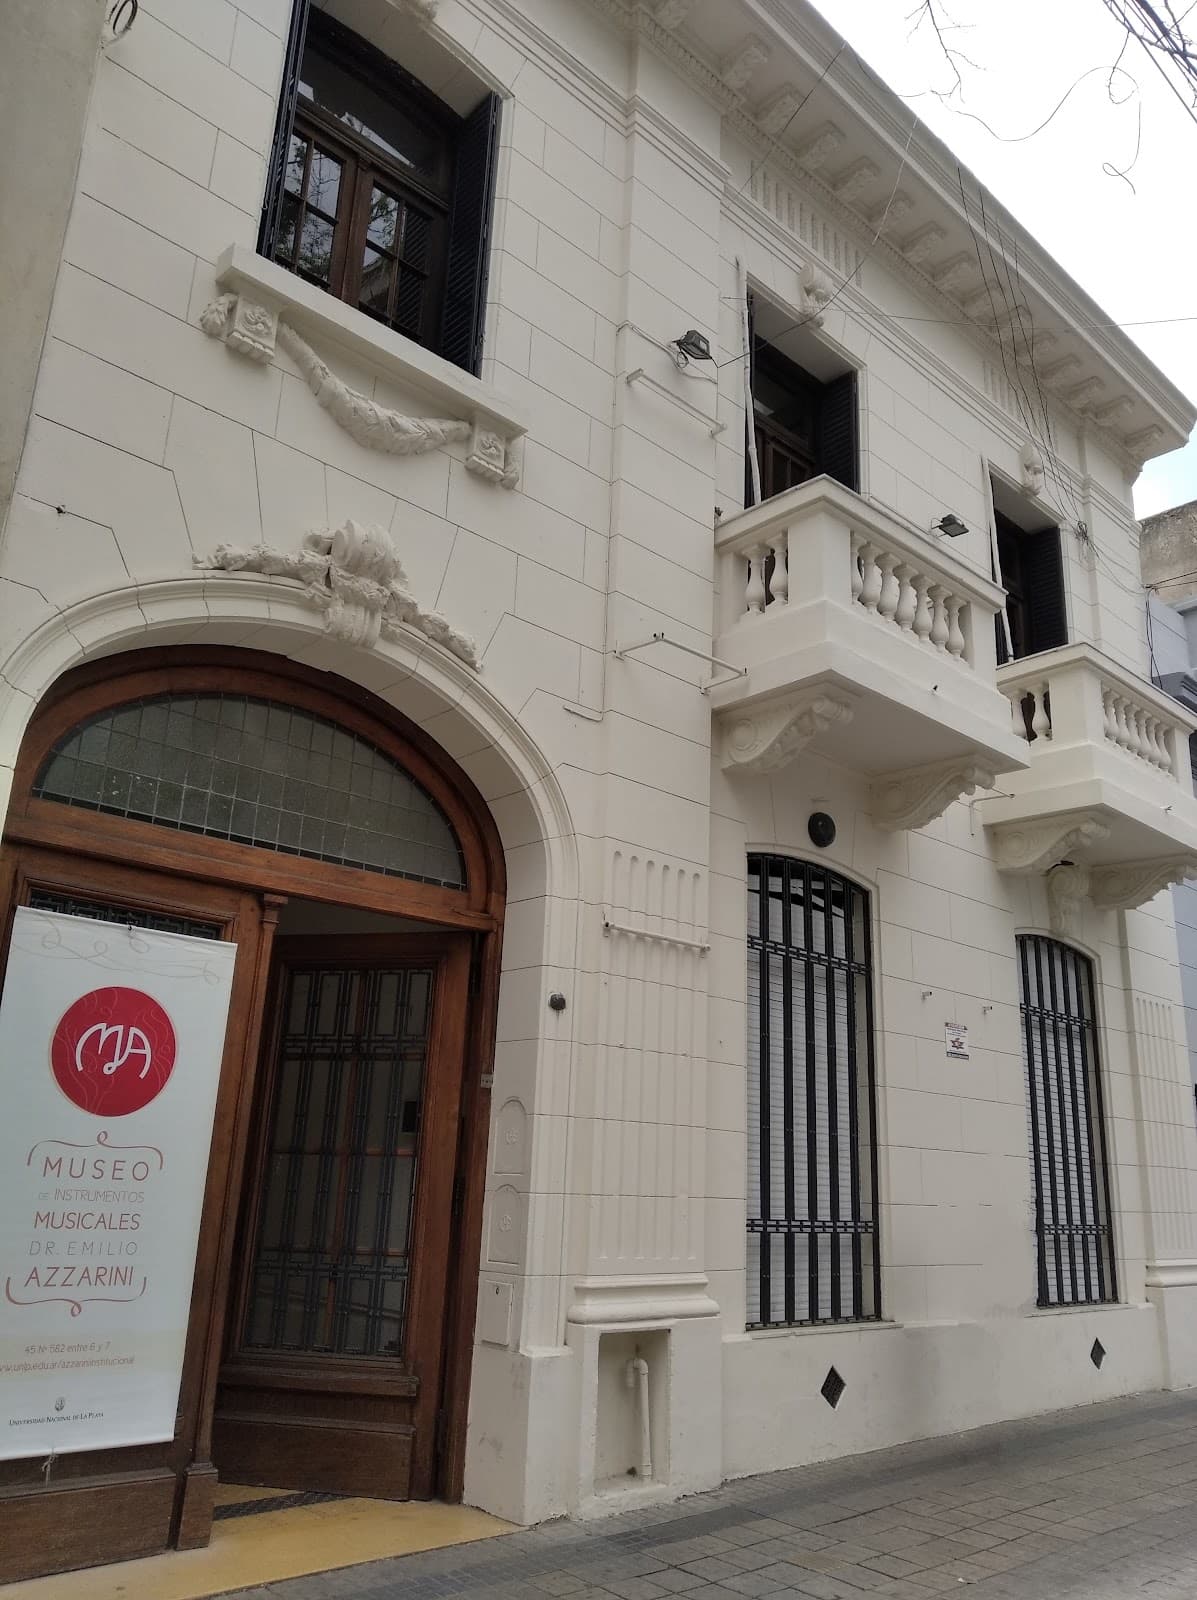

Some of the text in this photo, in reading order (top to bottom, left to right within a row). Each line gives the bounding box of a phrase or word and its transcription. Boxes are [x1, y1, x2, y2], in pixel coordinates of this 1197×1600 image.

[42, 1156, 149, 1182] MUSEO
[54, 1187, 145, 1203] INSTRUMENTOS
[34, 1210, 141, 1231] MUSICALES
[29, 1240, 138, 1256] DR. EMILIO
[24, 1265, 134, 1288] AZZARINI
